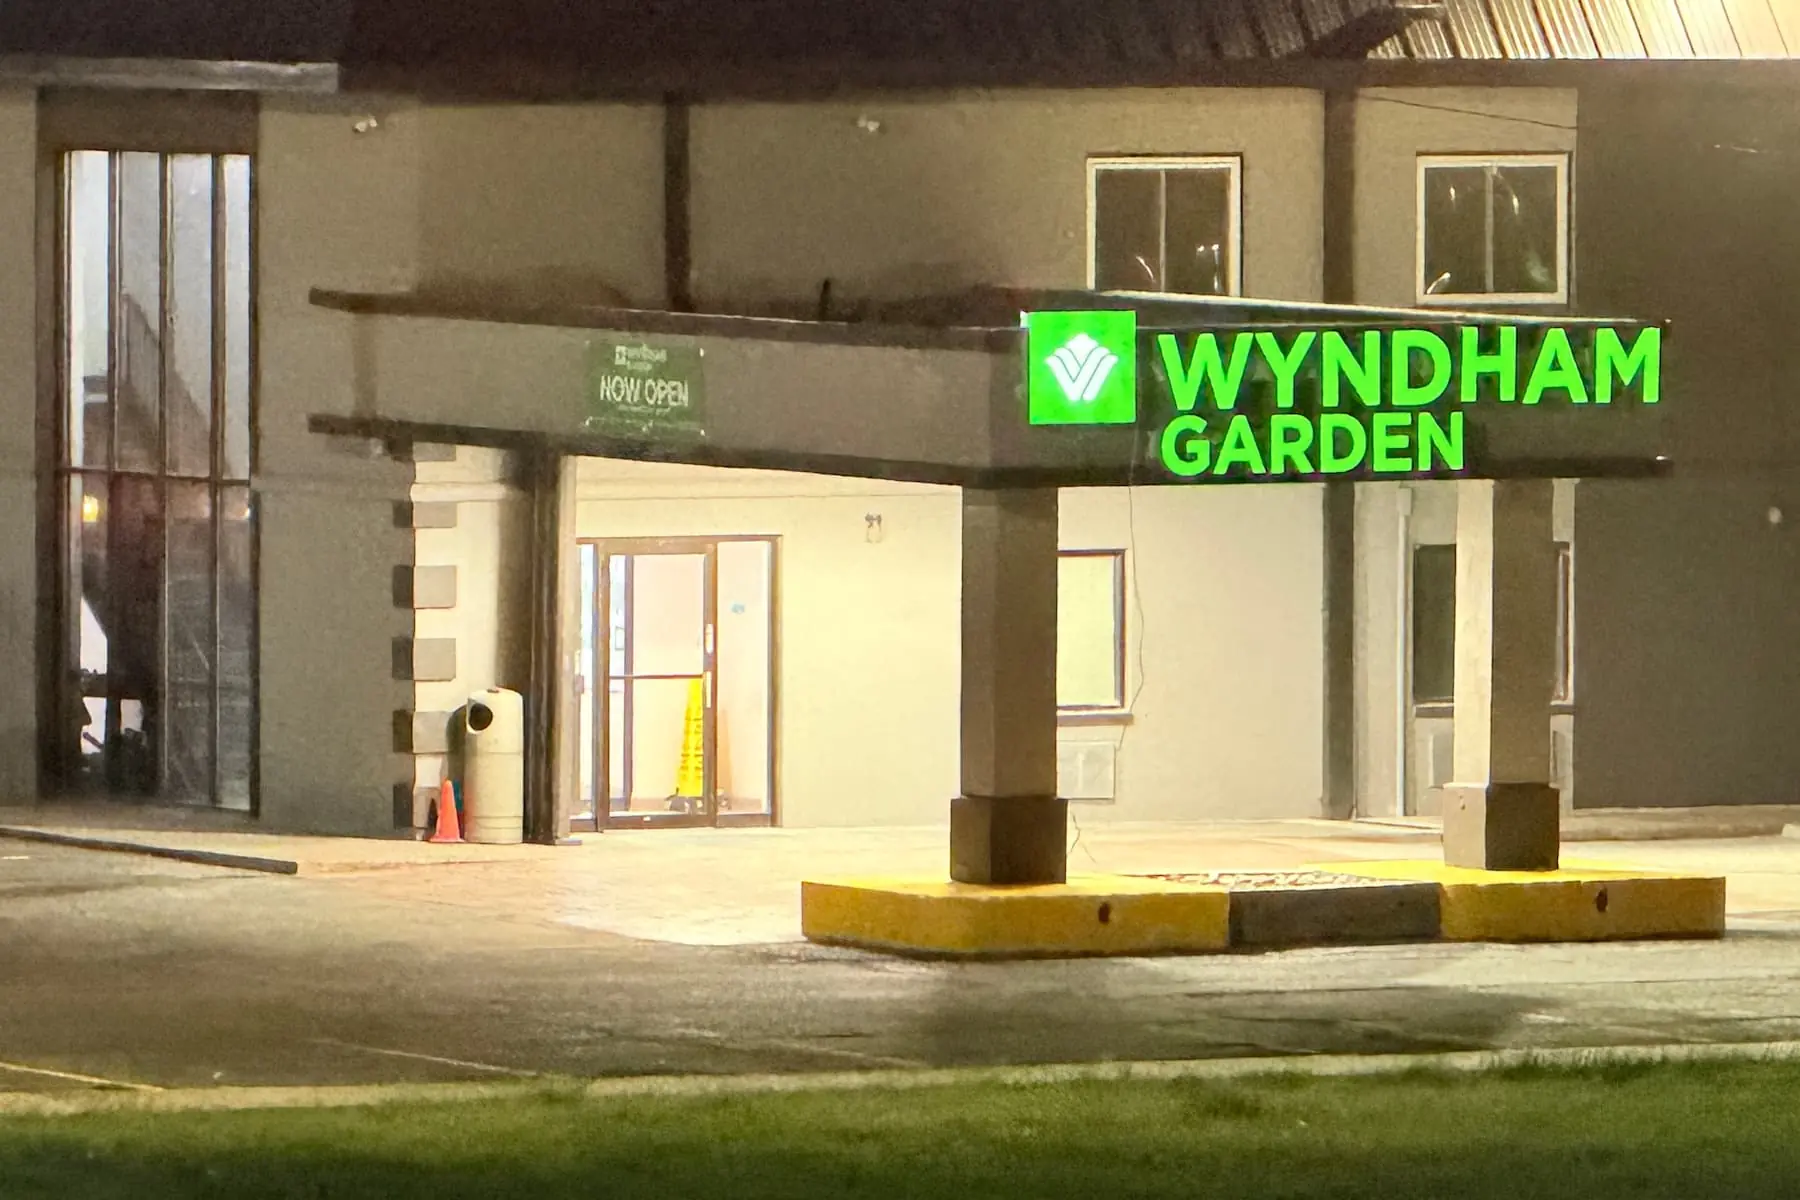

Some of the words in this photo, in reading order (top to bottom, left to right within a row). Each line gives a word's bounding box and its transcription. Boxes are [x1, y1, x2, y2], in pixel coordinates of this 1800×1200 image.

[600, 375, 641, 403] NOW
[645, 378, 689, 407] OPEN
[1158, 327, 1662, 411] WYNDHAM
[1160, 411, 1465, 476] GARDEN
